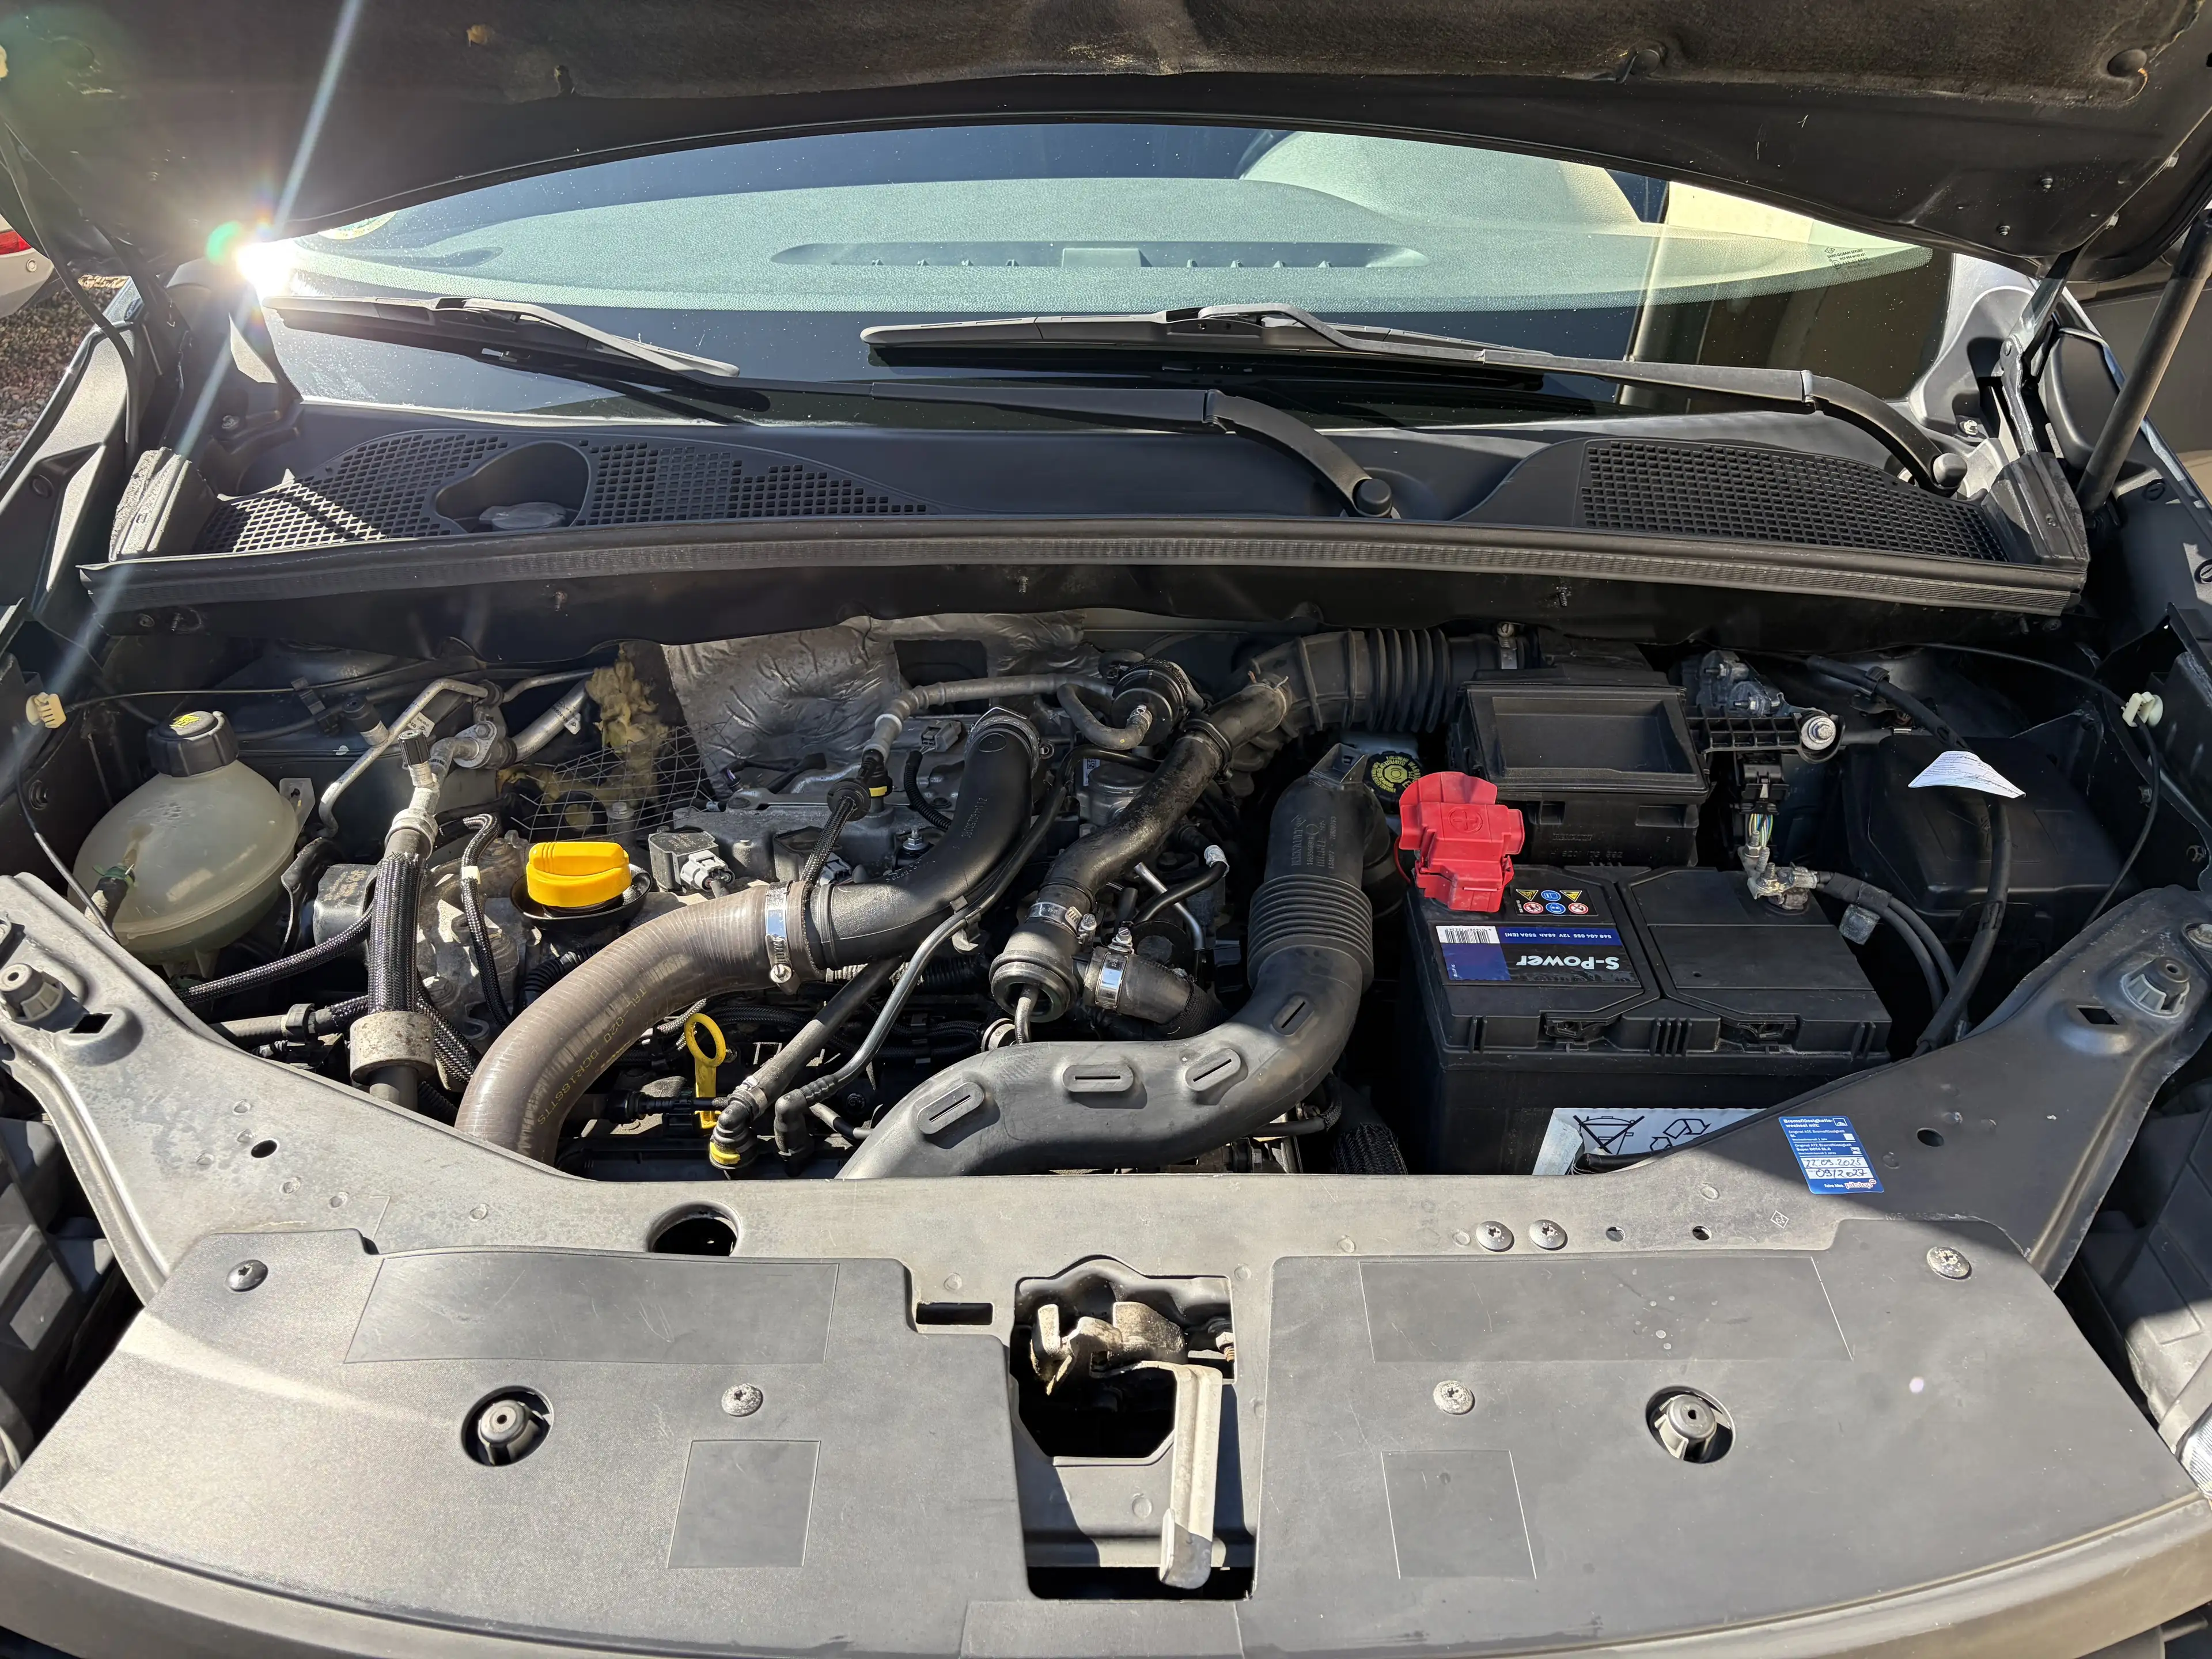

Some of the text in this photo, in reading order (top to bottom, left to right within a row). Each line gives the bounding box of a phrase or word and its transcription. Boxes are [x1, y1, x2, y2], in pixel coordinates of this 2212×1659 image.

[1291, 828, 1303, 866] RENAULT
[1516, 955, 1620, 970] S-Power
[537, 1048, 600, 1124] DCR186TTS
